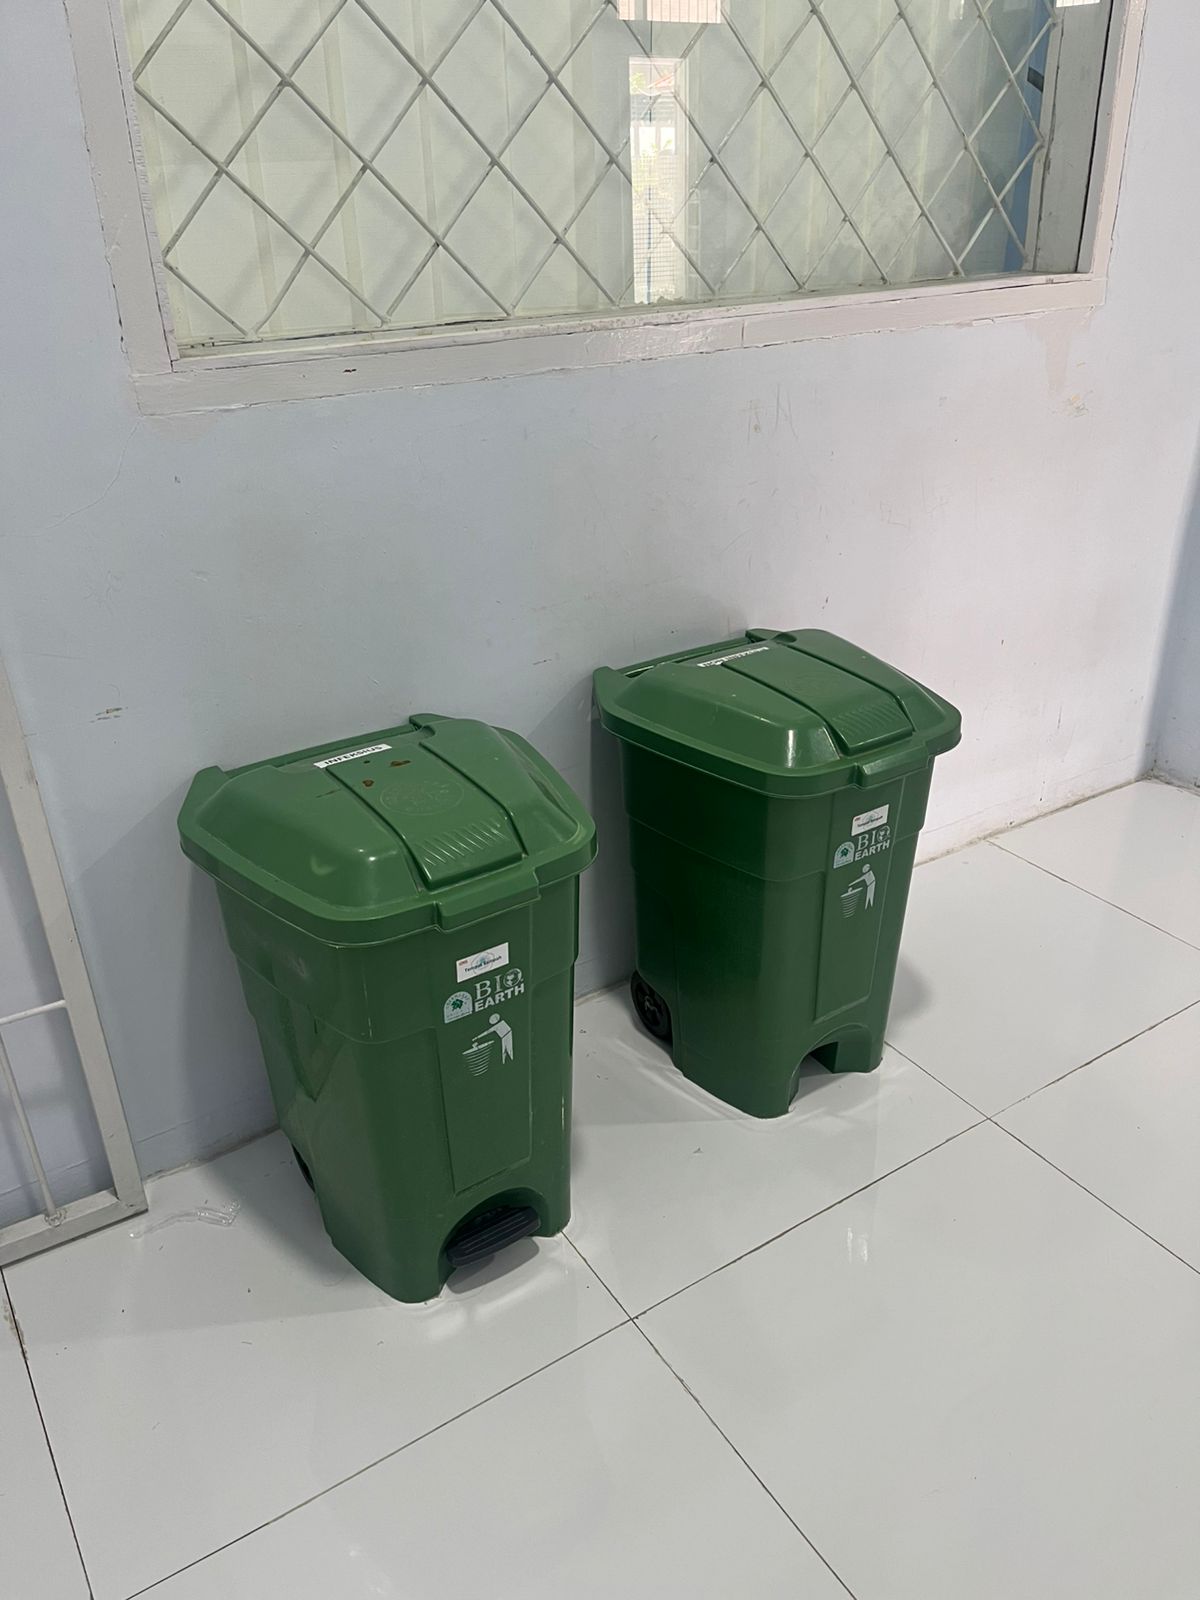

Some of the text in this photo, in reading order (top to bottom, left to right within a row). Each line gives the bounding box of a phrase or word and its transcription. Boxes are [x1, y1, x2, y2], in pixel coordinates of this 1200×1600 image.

[324, 746, 383, 765] INFEKSIUS
[854, 839, 890, 861] EARTH
[474, 983, 525, 1012] EARTH
